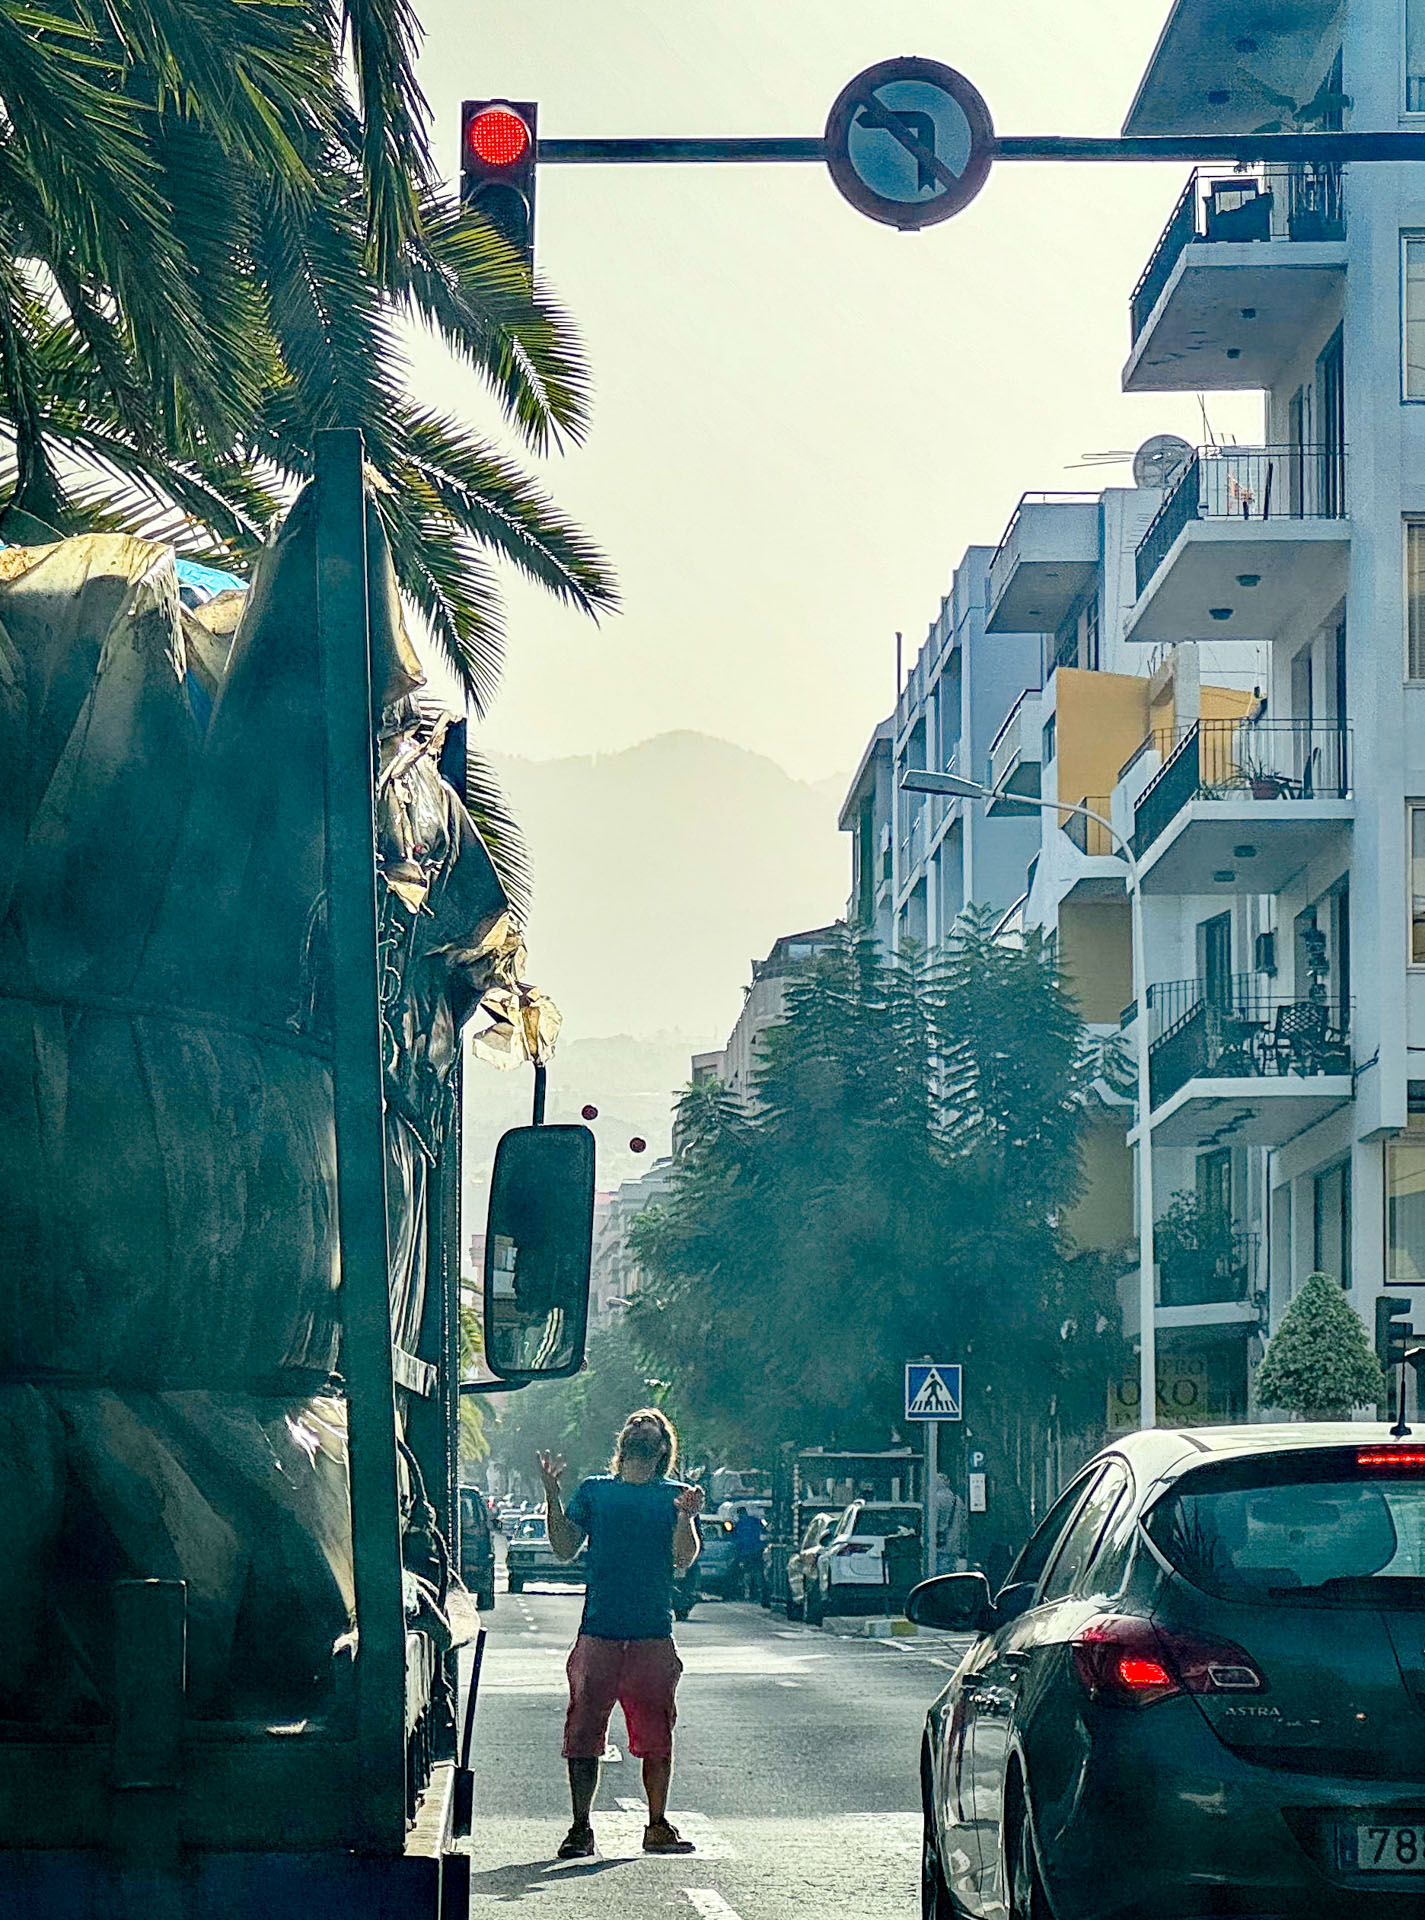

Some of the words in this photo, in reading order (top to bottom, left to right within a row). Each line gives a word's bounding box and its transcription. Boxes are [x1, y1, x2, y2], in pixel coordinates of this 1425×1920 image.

[1117, 1378, 1198, 1406] ORO
[973, 1451, 984, 1467] P
[1224, 1706, 1281, 1717] ASTRA
[1368, 1828, 1425, 1865] 78
